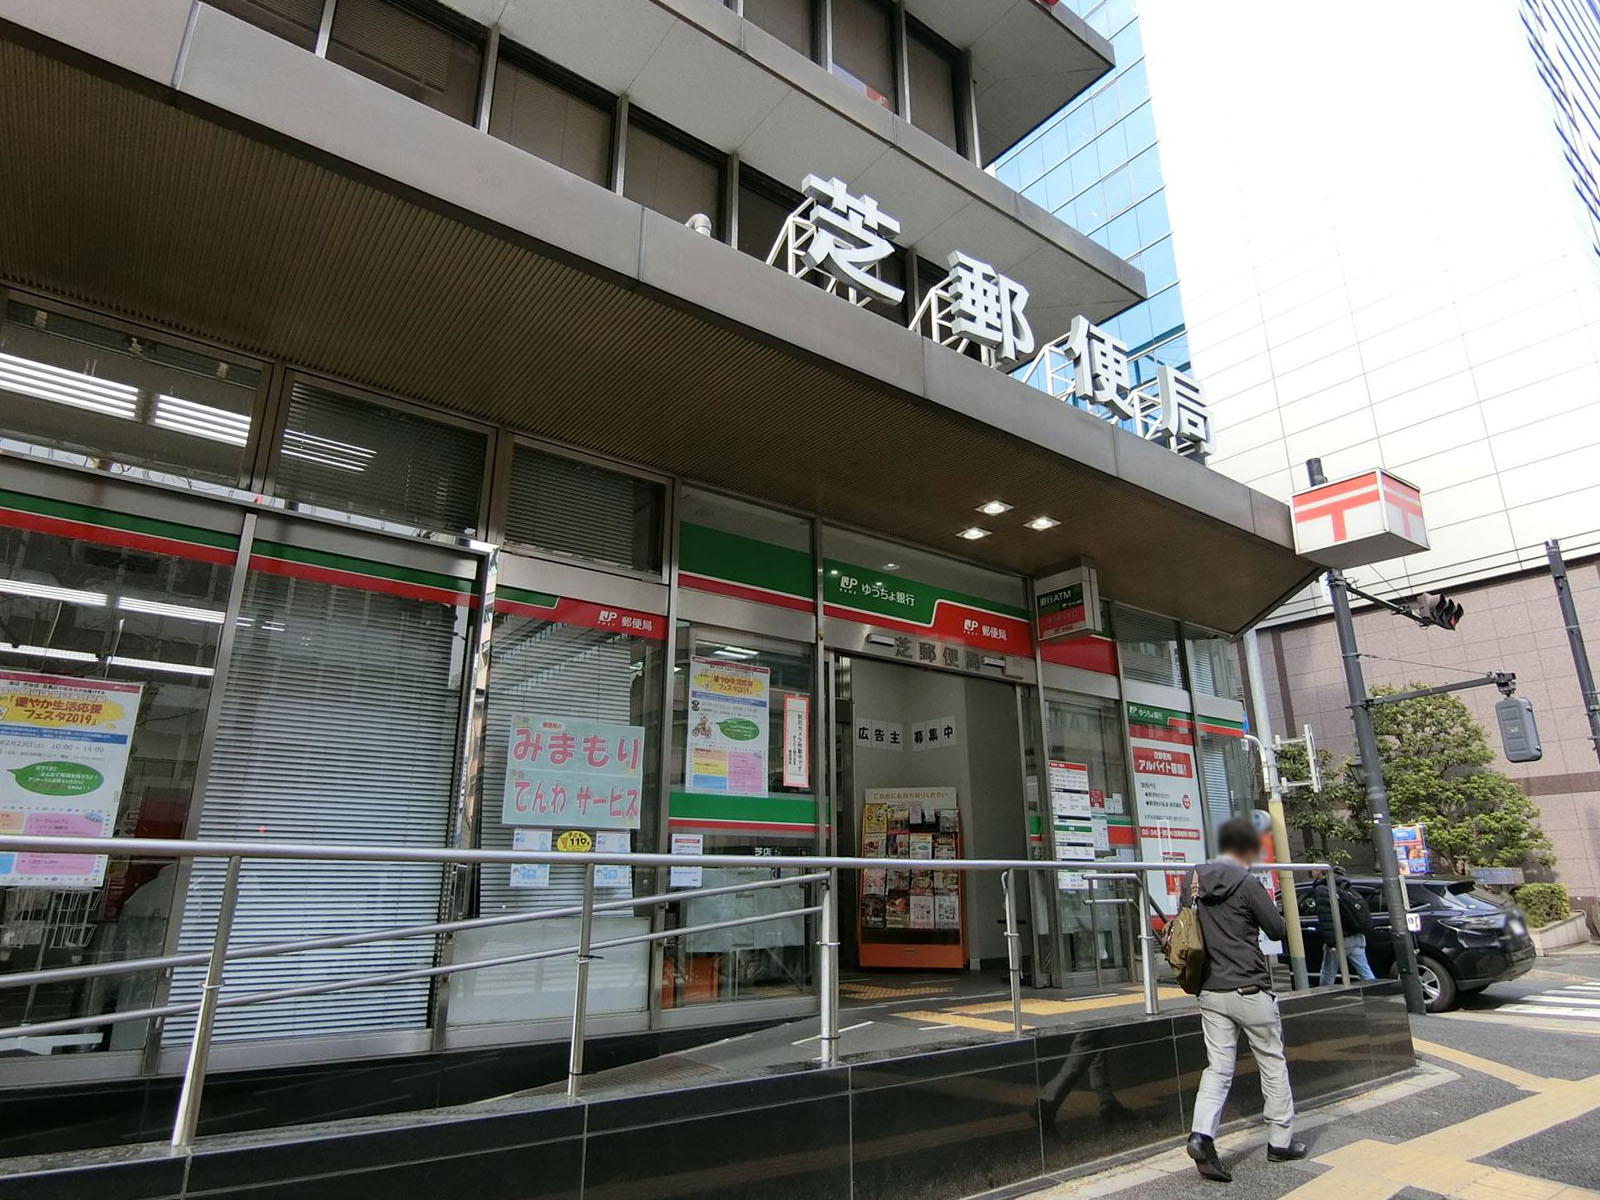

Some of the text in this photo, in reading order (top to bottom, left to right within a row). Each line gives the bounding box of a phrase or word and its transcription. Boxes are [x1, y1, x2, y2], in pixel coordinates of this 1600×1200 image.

[801, 172, 1217, 457] 芝郵便局
[861, 583, 916, 607] ゆうちょ銀行
[621, 615, 653, 632] 郵便局
[981, 625, 1008, 641] 郵便局
[858, 725, 953, 744] 広告主 募集中
[513, 726, 640, 770] みまもり
[577, 783, 639, 818] サービス
